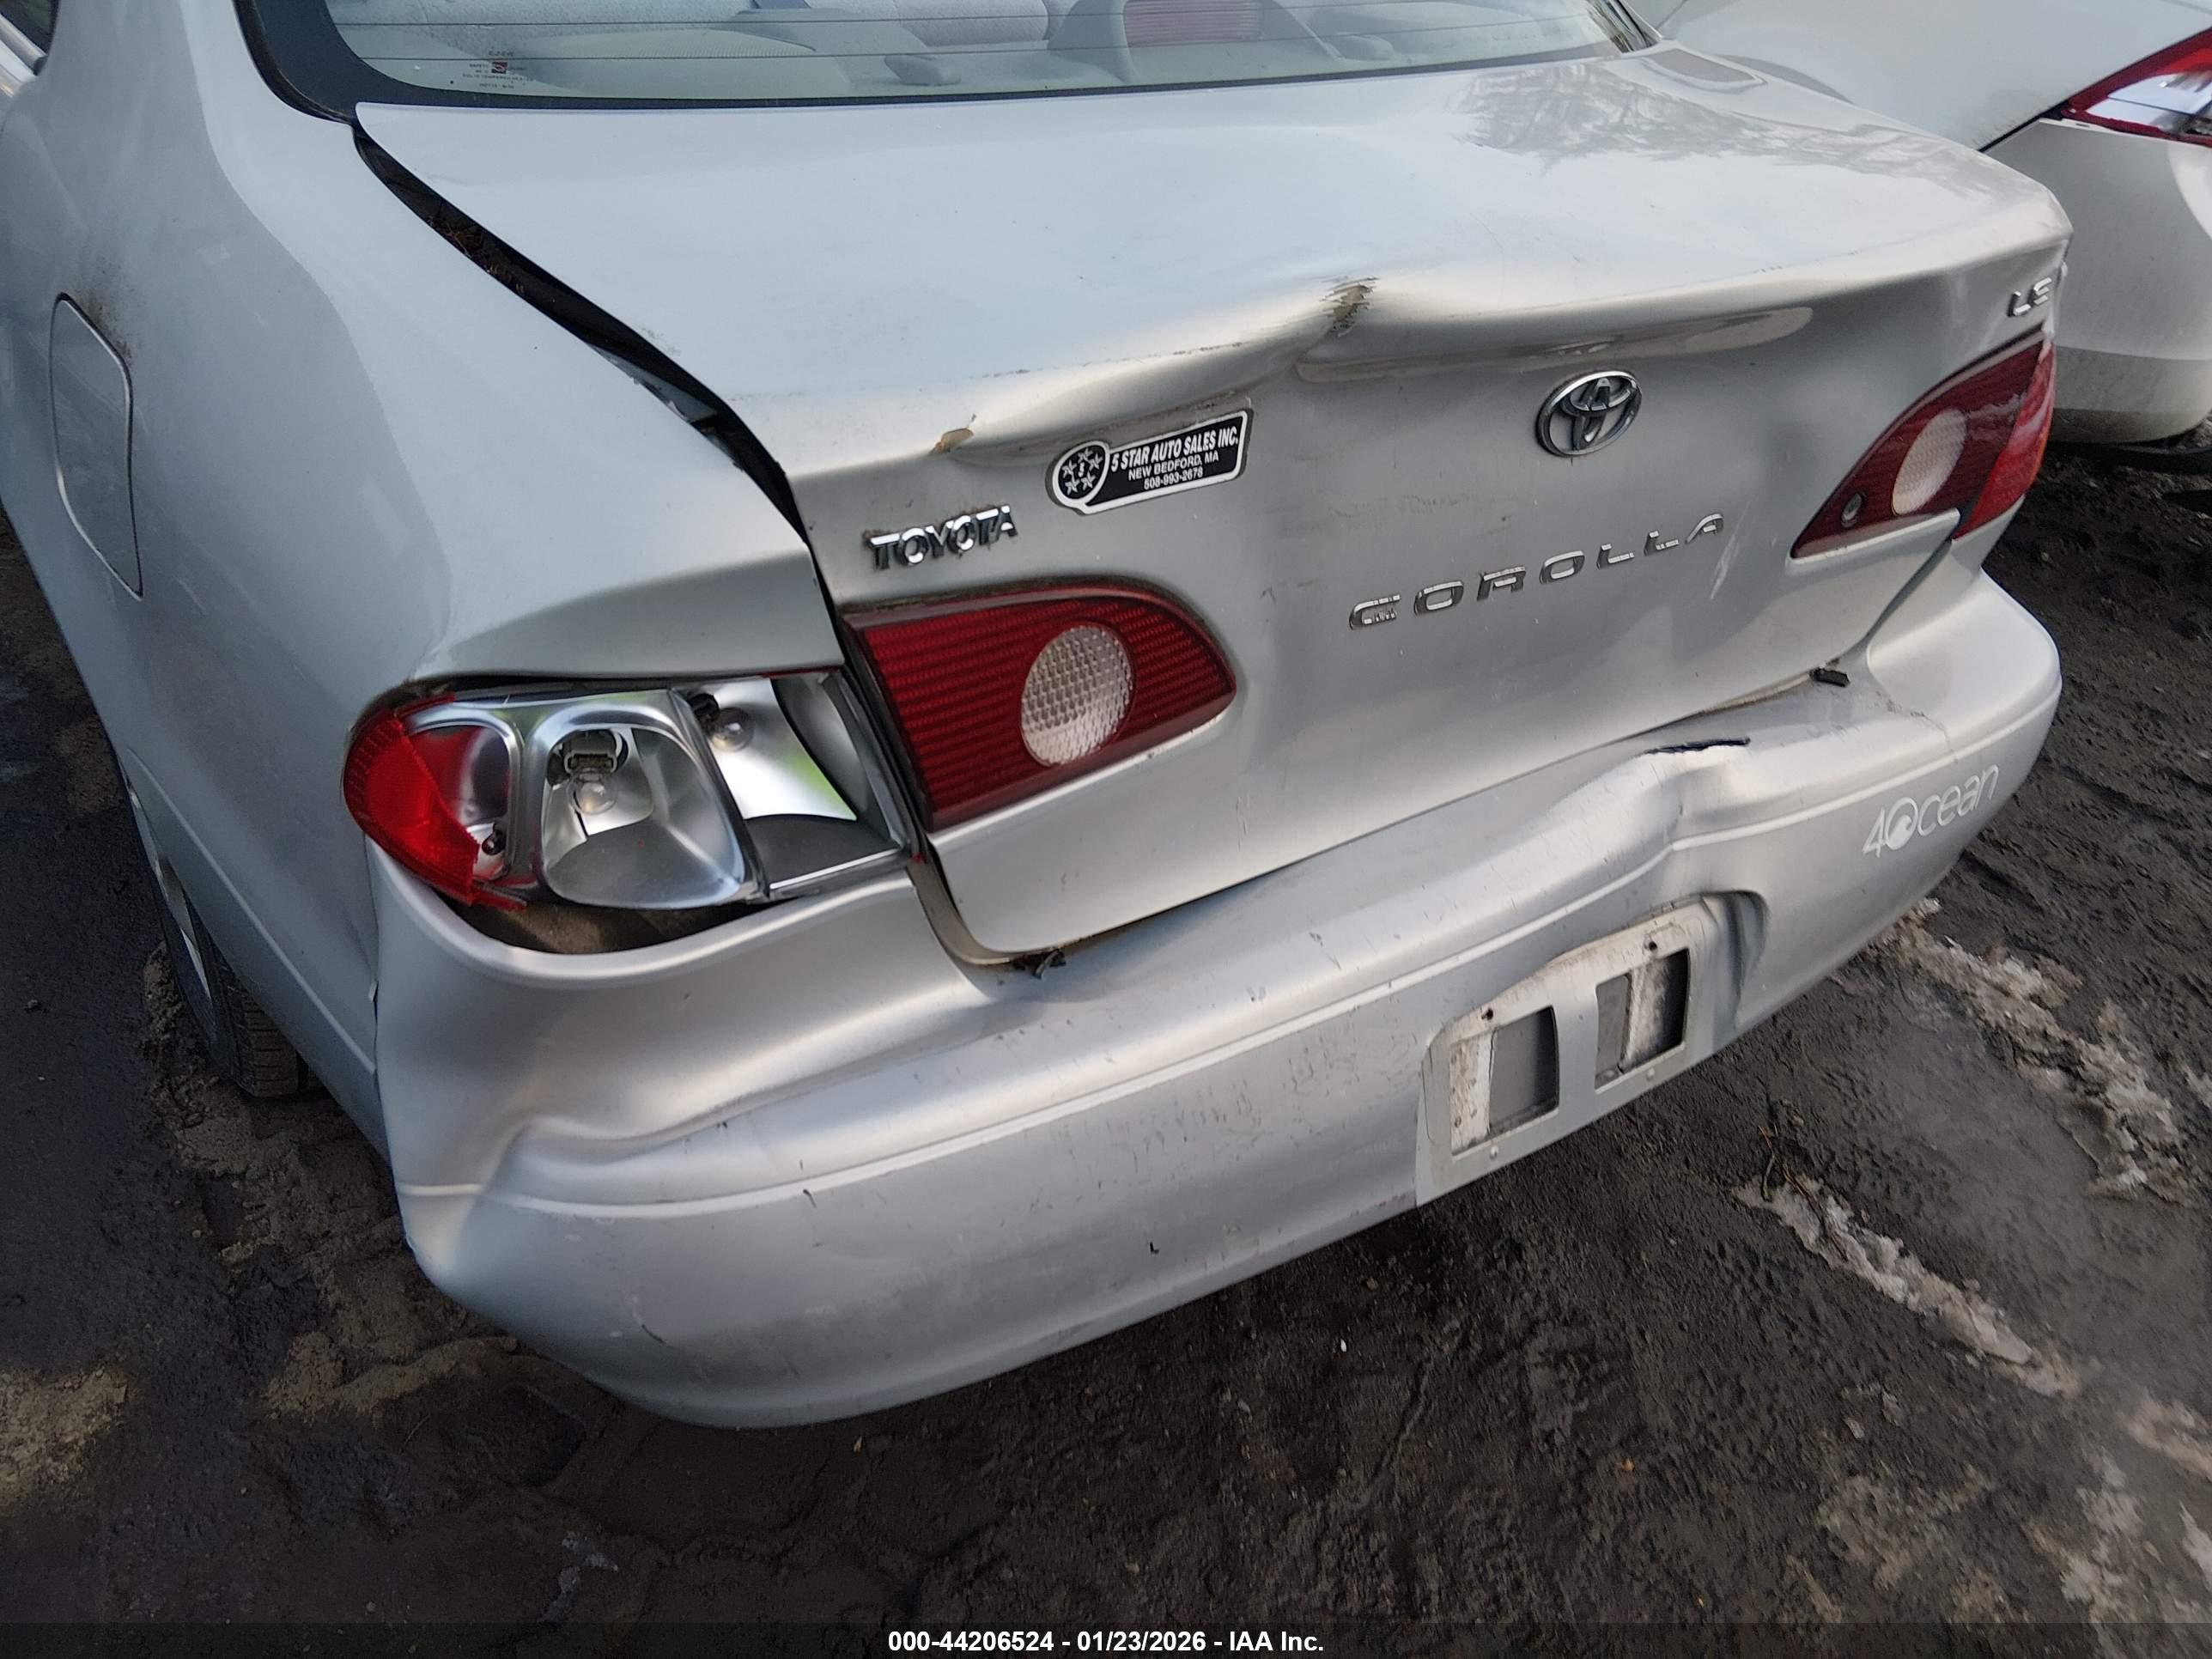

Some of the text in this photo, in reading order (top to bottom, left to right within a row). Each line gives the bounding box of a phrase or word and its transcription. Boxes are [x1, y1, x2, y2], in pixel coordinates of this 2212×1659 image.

[2007, 277, 2052, 317] LE
[1110, 426, 1238, 472] 5 STAR AUTO SALES INC.
[1128, 465, 1152, 481] NEW
[1204, 451, 1219, 464] MA
[867, 505, 1017, 569] TOYOTA
[1349, 513, 1723, 629] COROLLA
